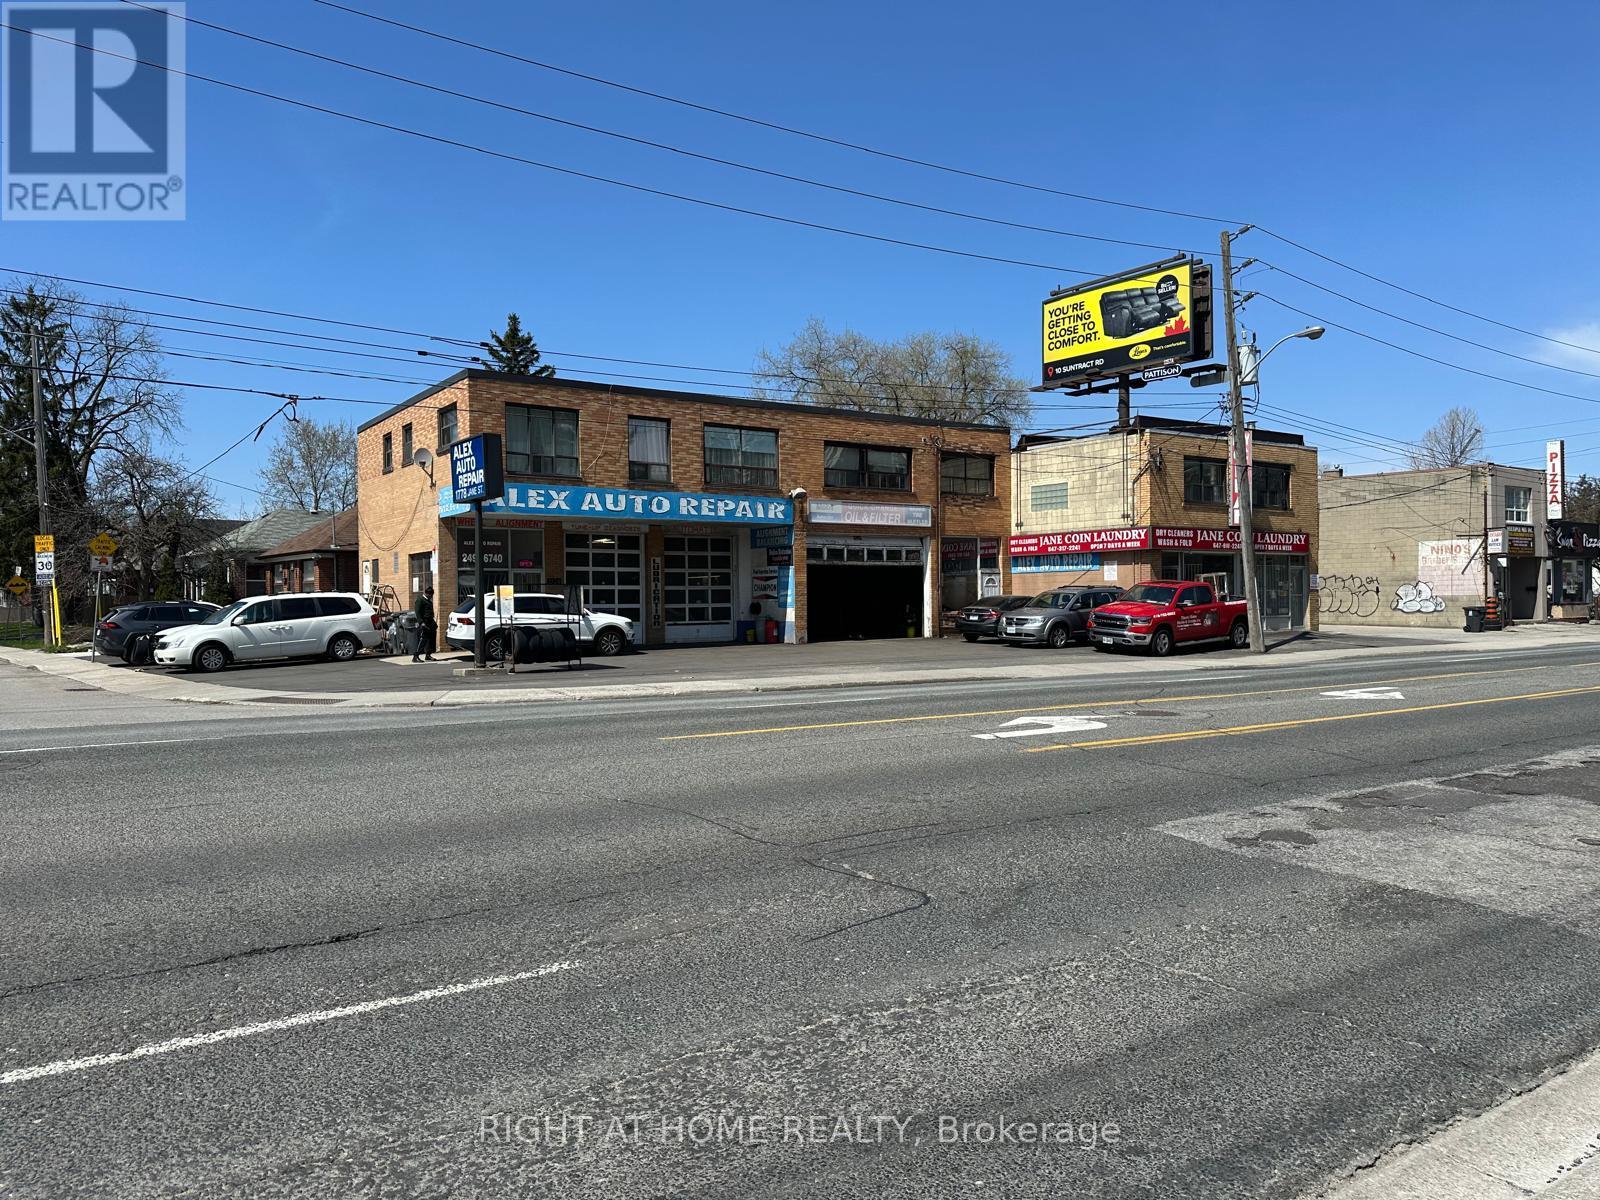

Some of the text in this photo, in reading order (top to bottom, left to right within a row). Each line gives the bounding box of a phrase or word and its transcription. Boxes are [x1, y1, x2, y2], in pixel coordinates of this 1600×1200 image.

[1048, 301, 1085, 318] YOU'RE
[1048, 311, 1091, 330] GETTING
[1048, 321, 1096, 340] CLOSE TO
[1048, 331, 1100, 351] COMFORT.
[1062, 360, 1094, 372] SUNTRACT
[1144, 366, 1179, 378] PATTISON
[454, 441, 473, 460] ALEX
[456, 456, 476, 474] AUTO
[458, 469, 484, 488] REPAIR
[1549, 452, 1559, 505] PIZZA
[468, 487, 477, 497] JANE
[580, 492, 671, 514] AUTO
[679, 498, 785, 518] REPAIR
[495, 519, 544, 528] ALIGNMENT
[844, 511, 860, 522] OIL
[869, 512, 901, 524] FILTER
[1039, 529, 1147, 547] JANE COIN LAUNDRY
[1197, 530, 1224, 543] JANE
[1257, 532, 1306, 544] LAUNDRY
[38, 561, 52, 570] 30
[483, 553, 503, 563] 6740
[1039, 554, 1061, 571] AUTO
[1063, 553, 1094, 570] REPAIR
[753, 583, 777, 592] CHAMPION
